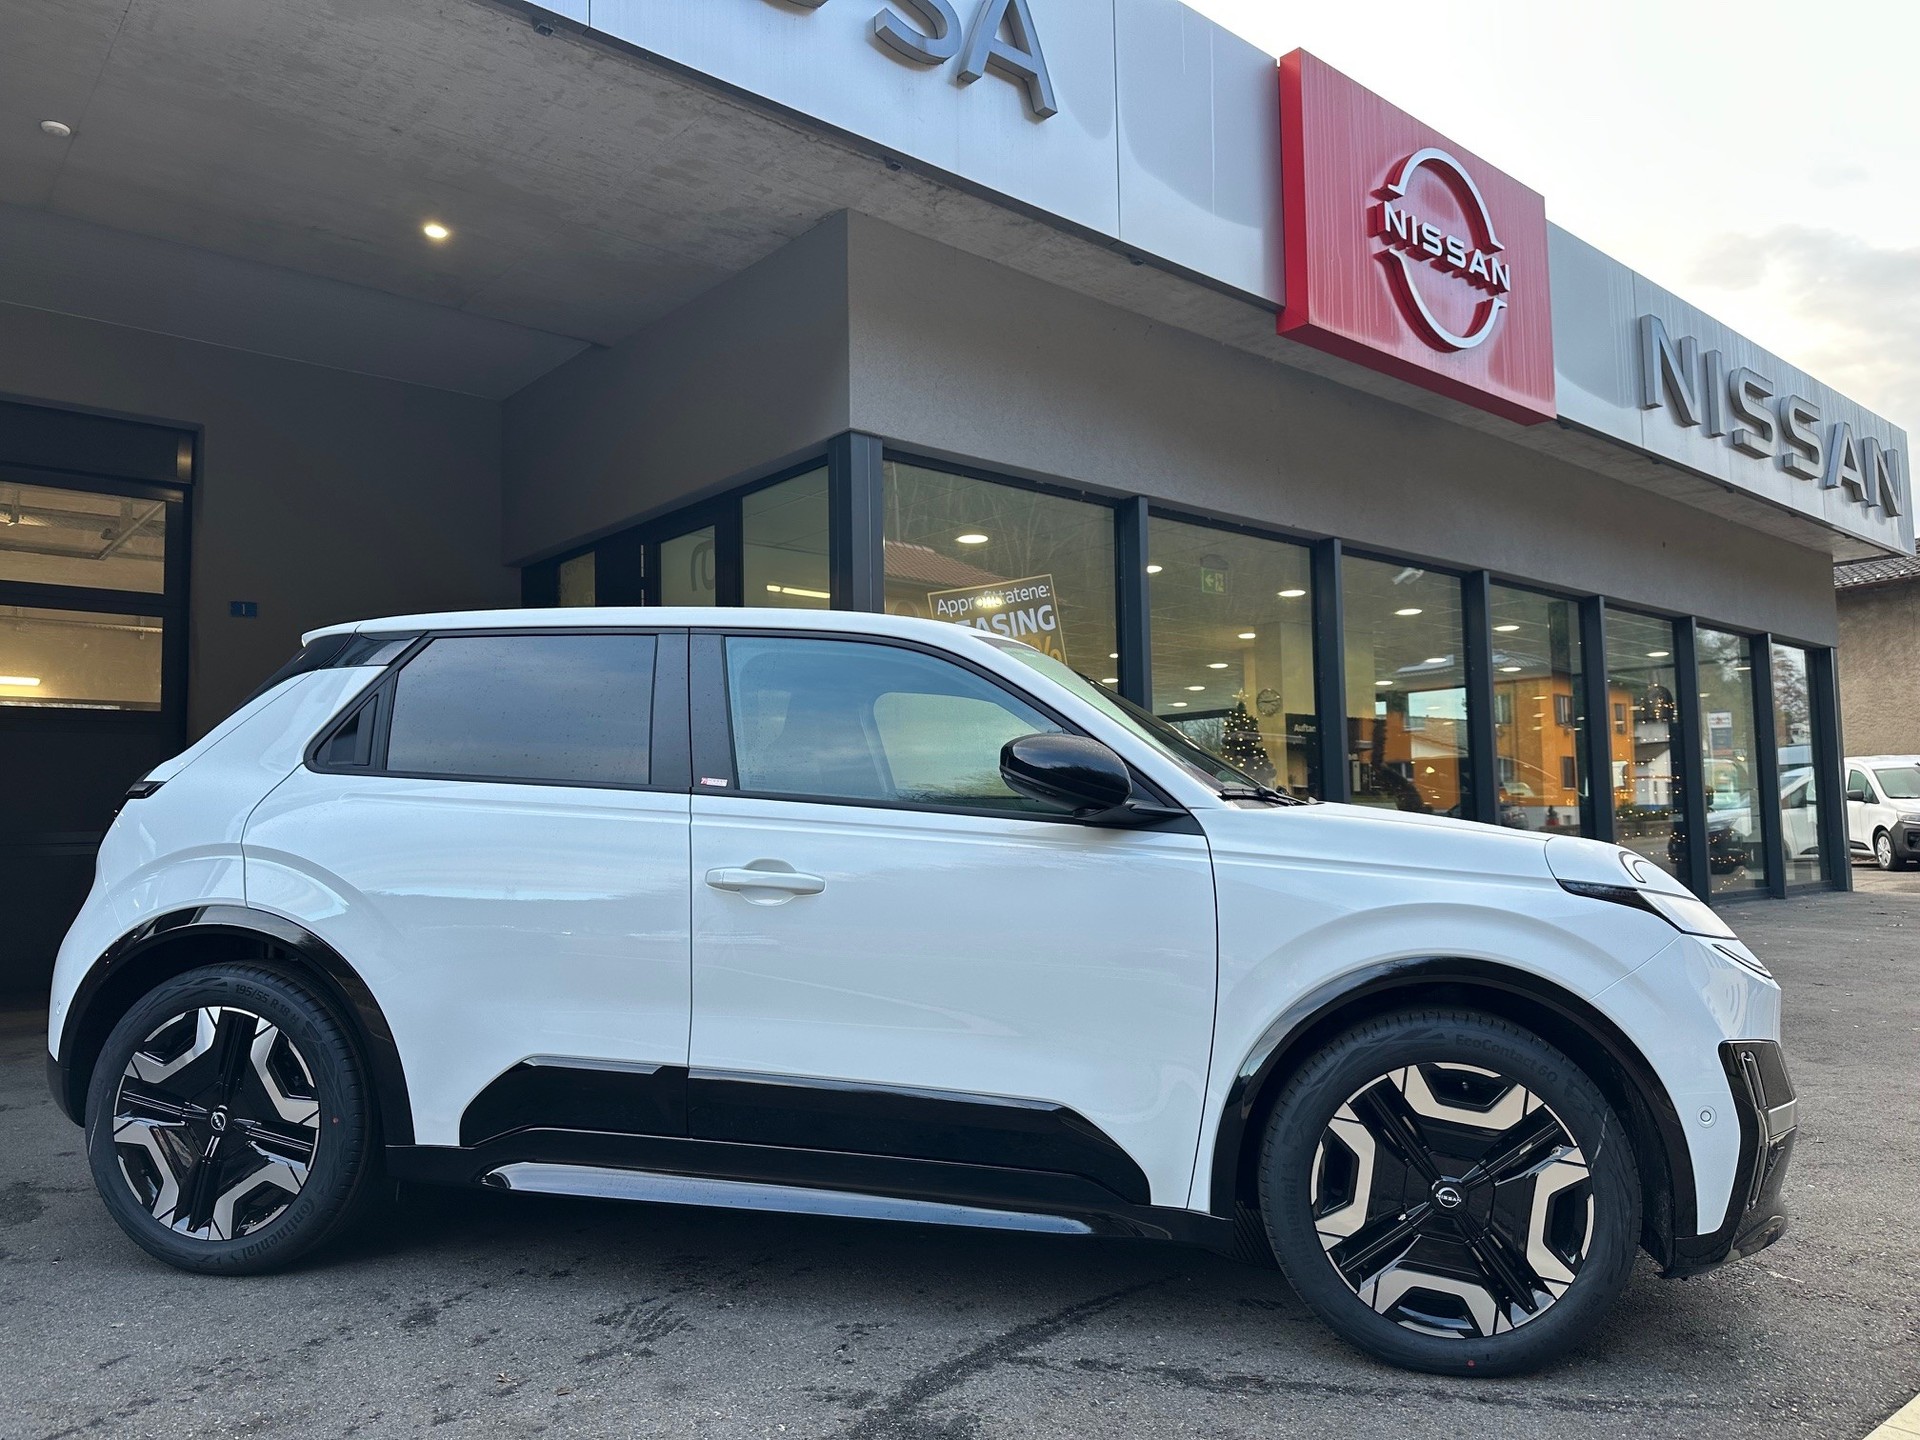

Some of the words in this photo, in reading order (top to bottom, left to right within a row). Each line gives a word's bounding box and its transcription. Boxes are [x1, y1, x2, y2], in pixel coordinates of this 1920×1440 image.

[1383, 200, 1511, 292] NISSAN
[1639, 313, 1902, 518] NISSAN
[235, 984, 271, 1004] 195/55
[1455, 1033, 1538, 1070] EcoContact
[241, 1199, 316, 1260] Continental
